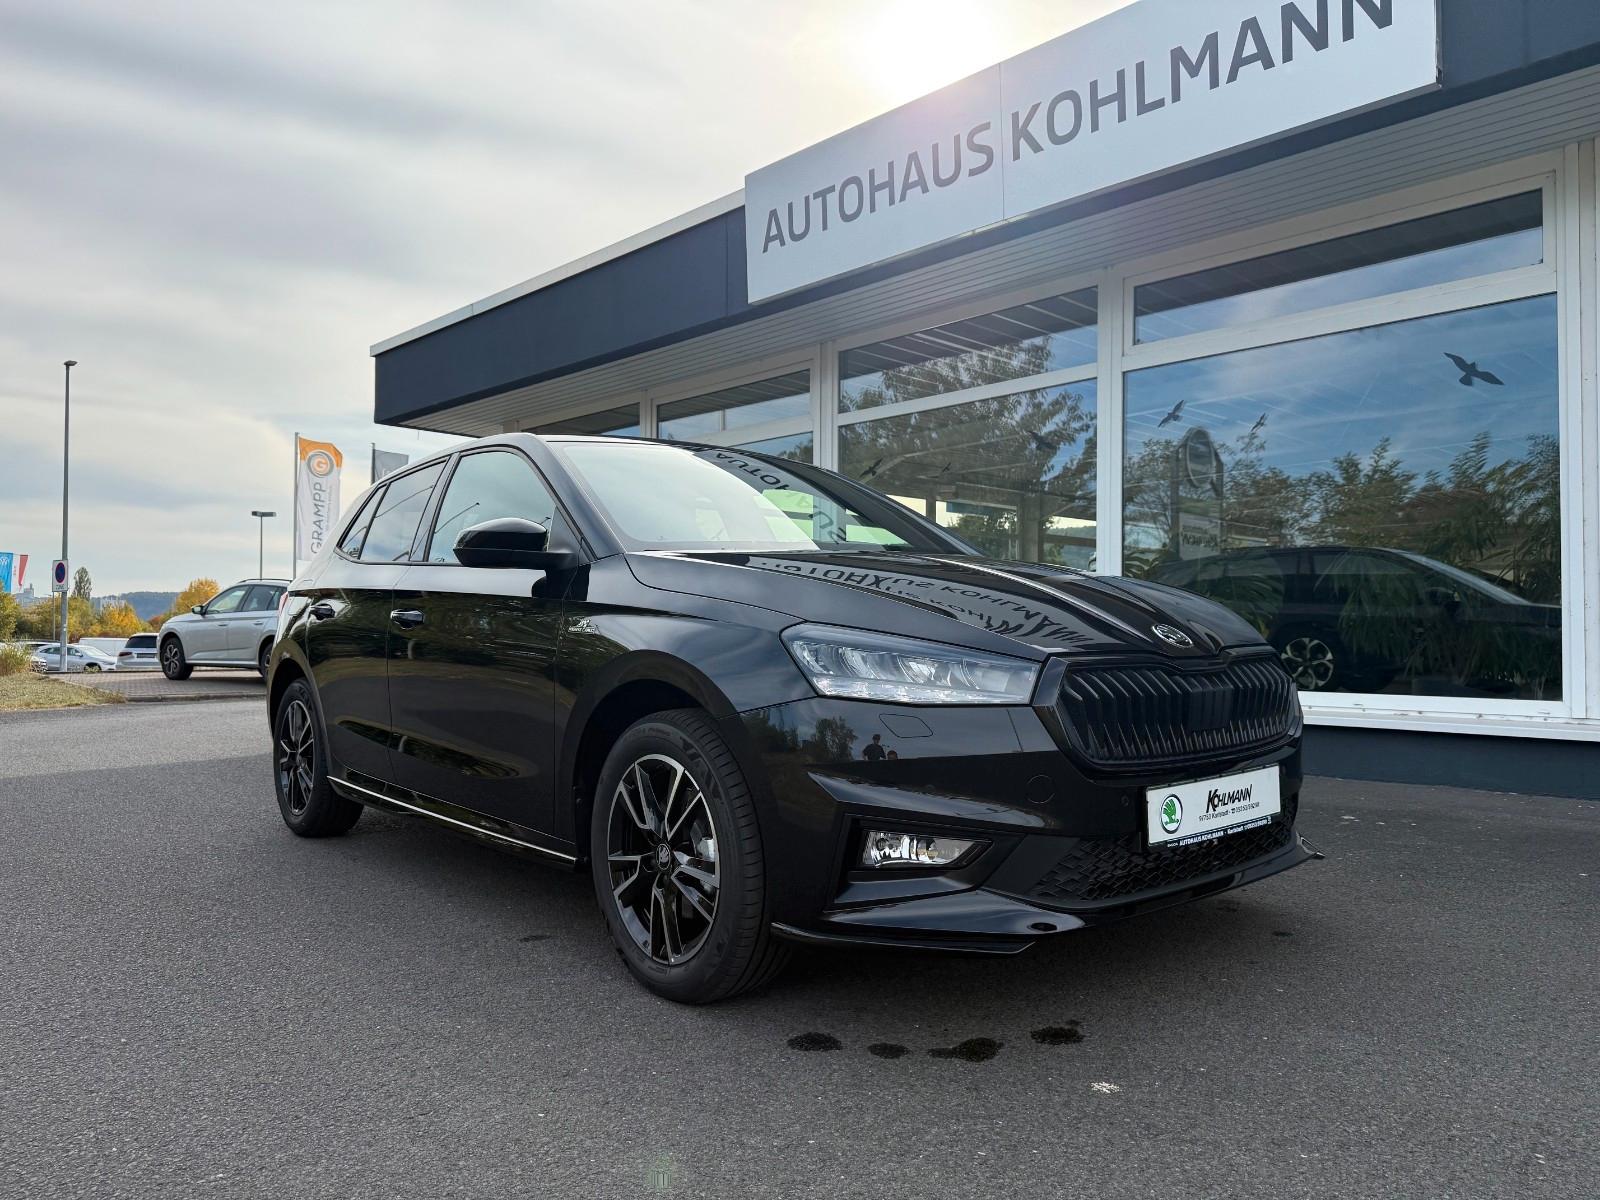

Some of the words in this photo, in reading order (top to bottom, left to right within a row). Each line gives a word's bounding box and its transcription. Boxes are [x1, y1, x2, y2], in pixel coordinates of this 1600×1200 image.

[762, 121, 995, 254] AUTOHAUS
[310, 481, 327, 554] GRAMPP
[1205, 783, 1253, 814] KOHLMANN
